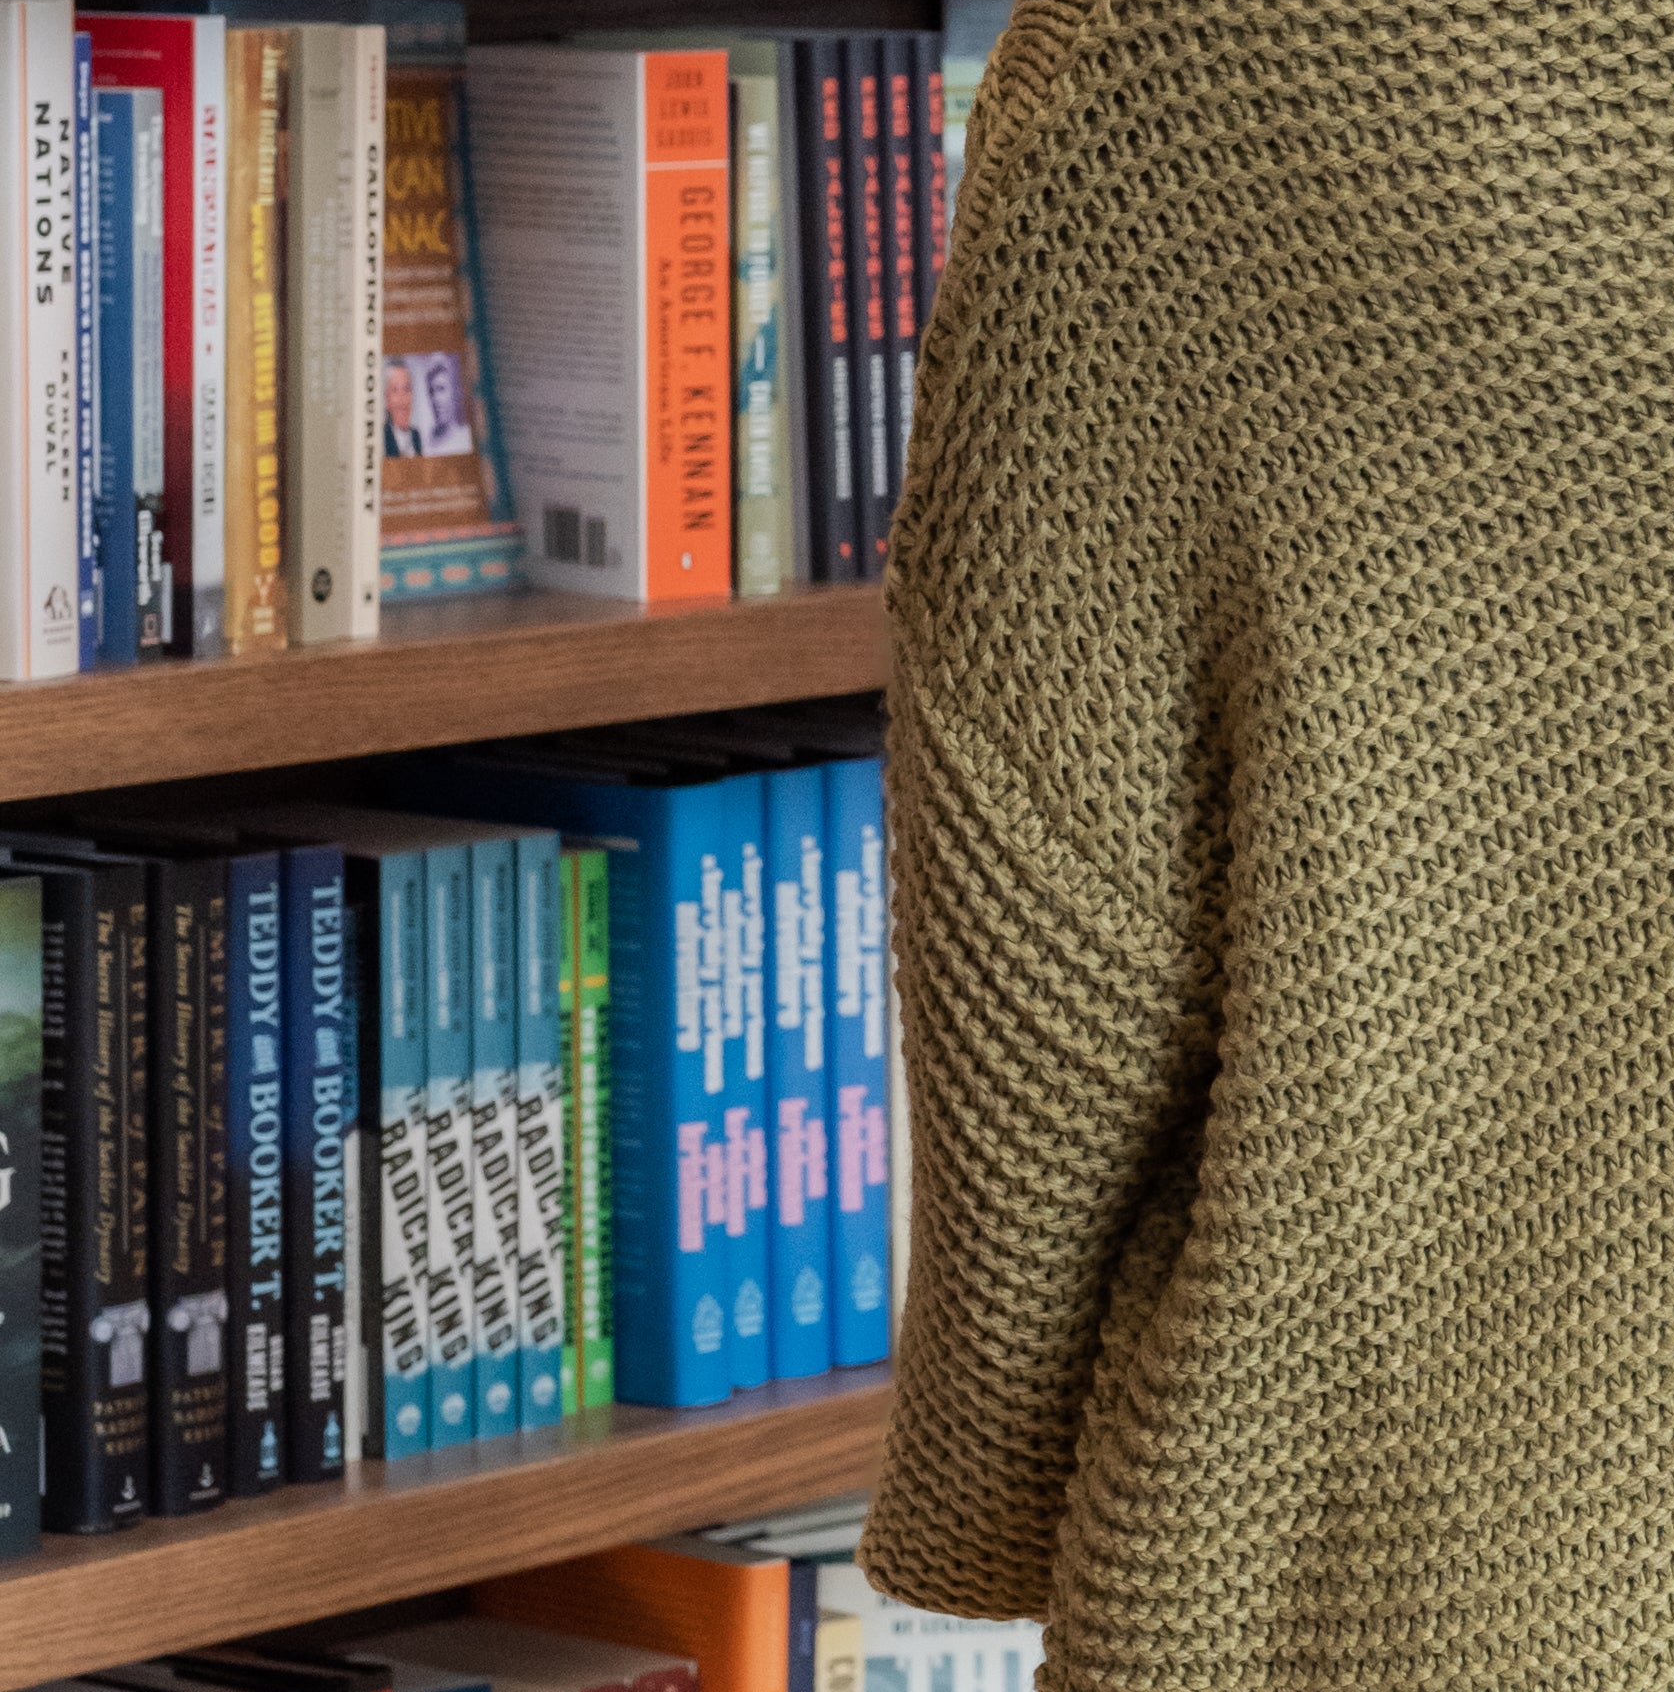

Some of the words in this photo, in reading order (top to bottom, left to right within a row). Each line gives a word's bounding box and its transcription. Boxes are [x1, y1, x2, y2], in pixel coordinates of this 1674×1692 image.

[35, 101, 53, 305] NATIONS
[60, 118, 72, 283] NATIVE
[366, 144, 379, 338] GALLOPING
[680, 186, 716, 326] GEORGE
[62, 350, 71, 502] KATHLEEN
[681, 343, 716, 369] F.
[364, 350, 376, 512] GOURMET
[680, 385, 716, 532] KENNAN
[249, 881, 280, 1028] TEDDY
[312, 874, 344, 1020] TEDDY
[251, 1034, 277, 1076] and
[314, 1026, 342, 1069] and
[249, 1080, 282, 1268] BOOKER
[312, 1075, 345, 1258] BOOKER
[381, 1117, 428, 1288] RADICAL
[422, 1109, 473, 1279] RADICAL
[470, 1099, 519, 1266] RADICAL
[519, 1093, 563, 1259] RADICAL
[249, 1269, 281, 1311] T.
[313, 1261, 345, 1303] T.
[381, 1274, 424, 1373] KING
[428, 1265, 470, 1362] KING
[473, 1255, 514, 1352] KING
[519, 1247, 559, 1344] KING
